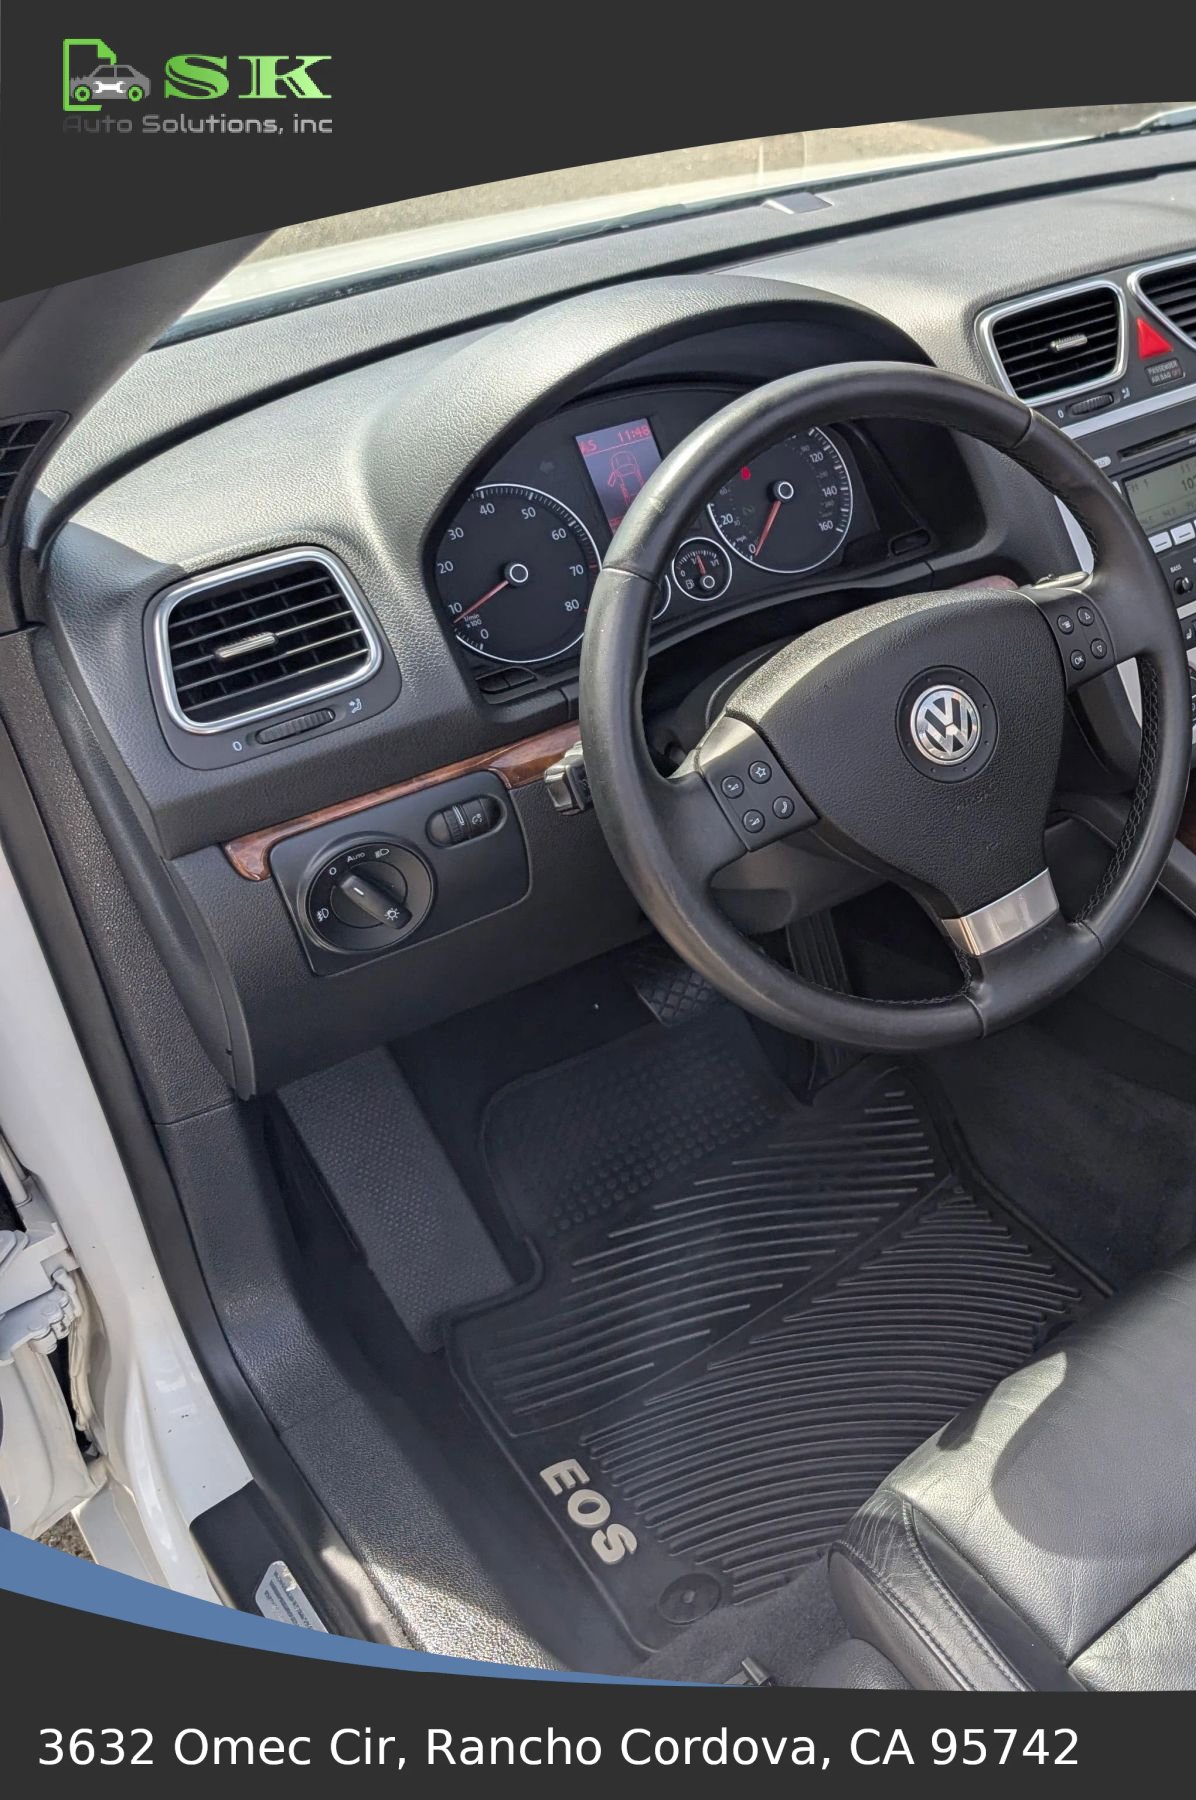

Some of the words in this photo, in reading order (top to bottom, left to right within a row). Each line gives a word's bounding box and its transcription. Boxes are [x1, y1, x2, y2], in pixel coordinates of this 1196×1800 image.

[809, 451, 824, 463] 120
[822, 485, 838, 497] 140
[479, 502, 495, 516] 40
[521, 506, 536, 520] 50
[720, 513, 734, 526] 20
[818, 520, 834, 532] 160
[448, 527, 464, 541] 30
[551, 528, 567, 541] 60
[748, 543, 756, 554] 0
[437, 560, 454, 574] 20
[569, 564, 584, 576] 70
[1170, 564, 1182, 574] BASS
[448, 602, 463, 615] 10
[564, 599, 580, 612] 80
[480, 628, 489, 640] 0
[1074, 656, 1084, 665] OK
[539, 1458, 638, 1565] EOS
